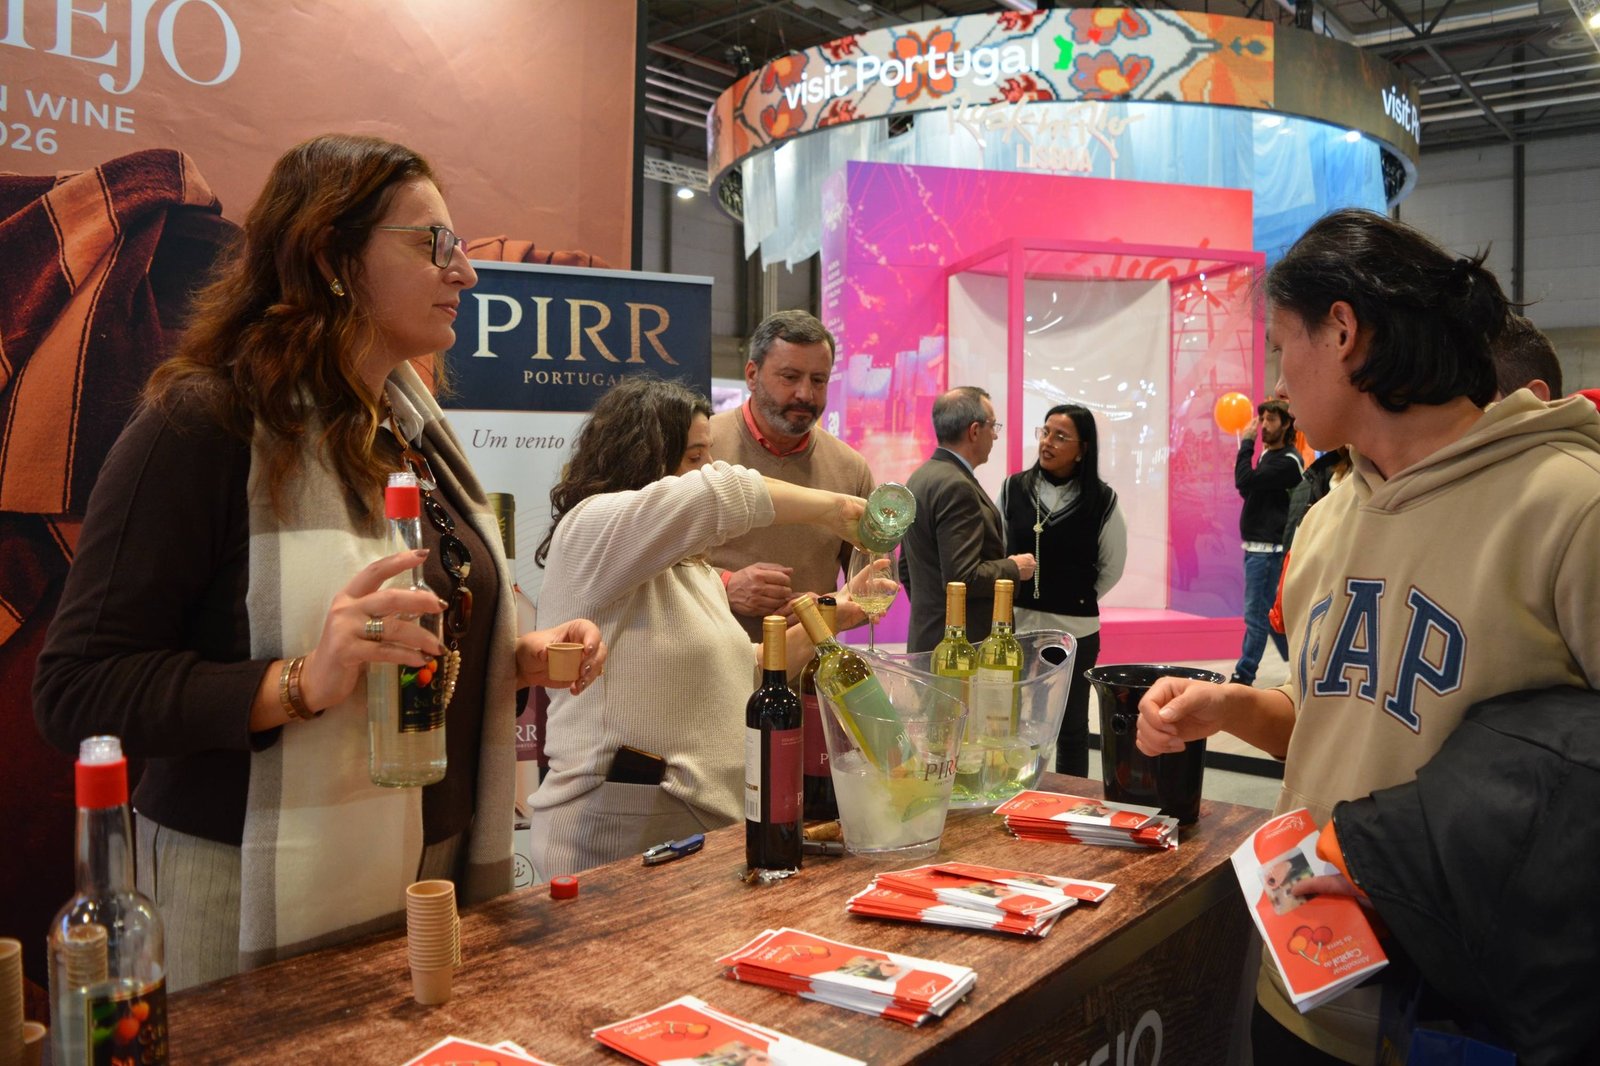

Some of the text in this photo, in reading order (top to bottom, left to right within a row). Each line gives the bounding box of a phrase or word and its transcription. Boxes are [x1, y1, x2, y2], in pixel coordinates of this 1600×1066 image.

[785, 37, 1040, 110] visit Portugal
[26, 89, 136, 134] WINE
[1381, 85, 1411, 131] visit
[471, 292, 680, 366] PIRR
[471, 429, 508, 448] Um
[515, 434, 565, 450] vento
[515, 724, 538, 742] RR
